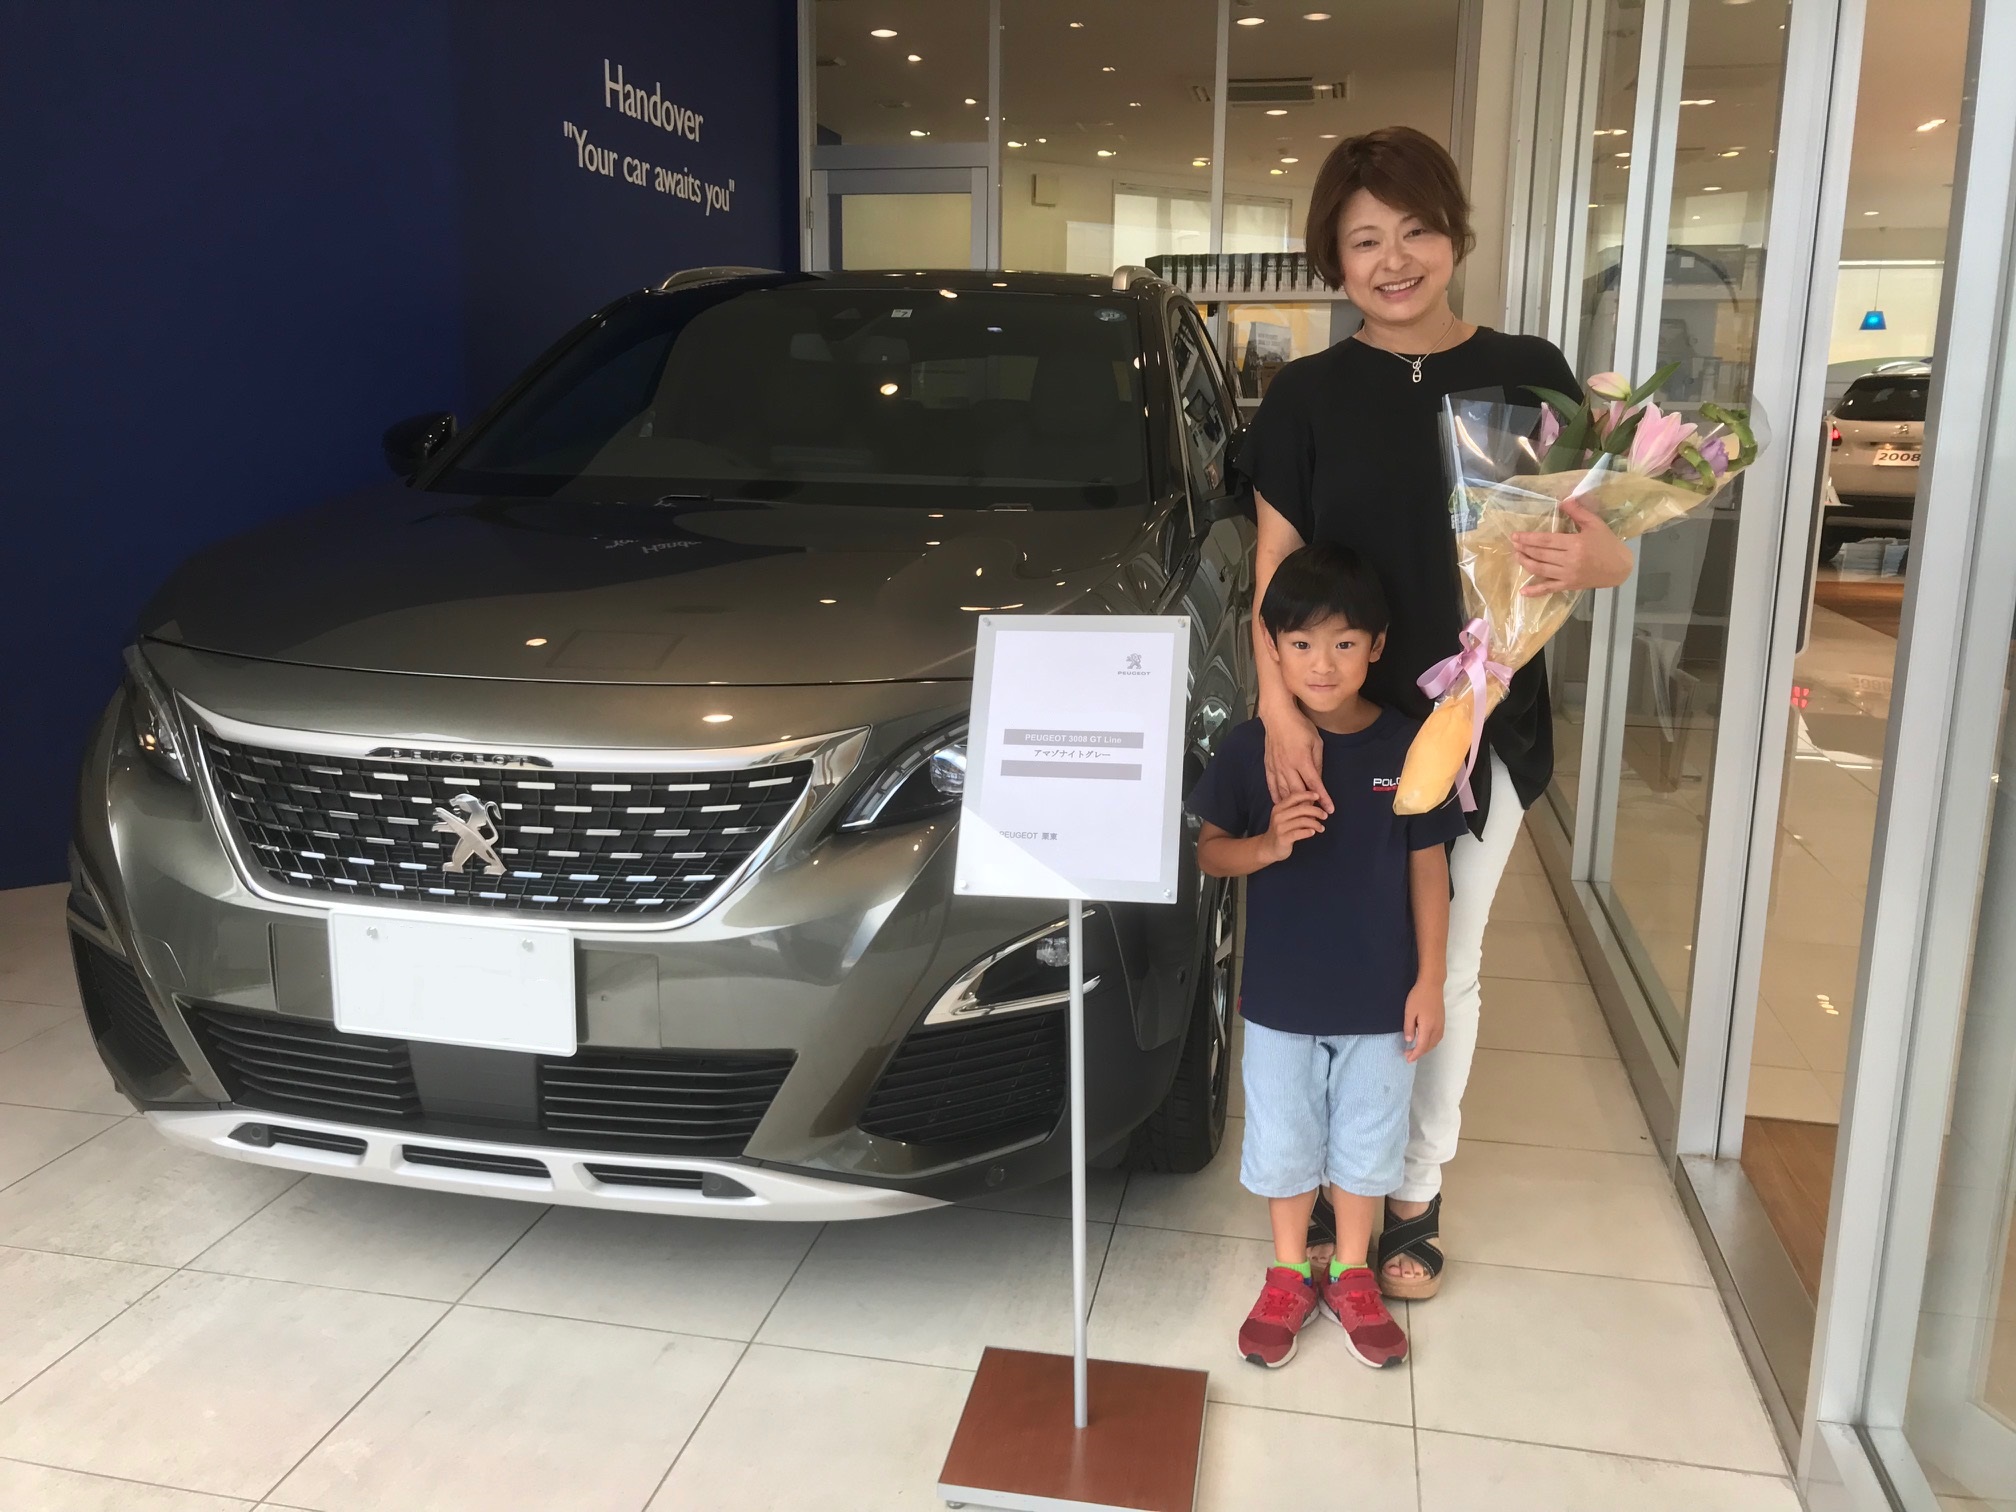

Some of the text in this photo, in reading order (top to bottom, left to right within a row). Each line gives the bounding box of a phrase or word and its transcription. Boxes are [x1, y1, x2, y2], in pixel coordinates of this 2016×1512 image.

[604, 58, 704, 142] Handover
[563, 121, 735, 216] "Your car awaits you"
[1878, 452, 1921, 462] 2008
[1025, 733, 1122, 744] PEUGEOT 3008 GT Line
[390, 748, 528, 767] PEUGEOT
[1034, 749, 1111, 759] アマゾナイトグレー
[999, 830, 1038, 840] PEUGEOT
